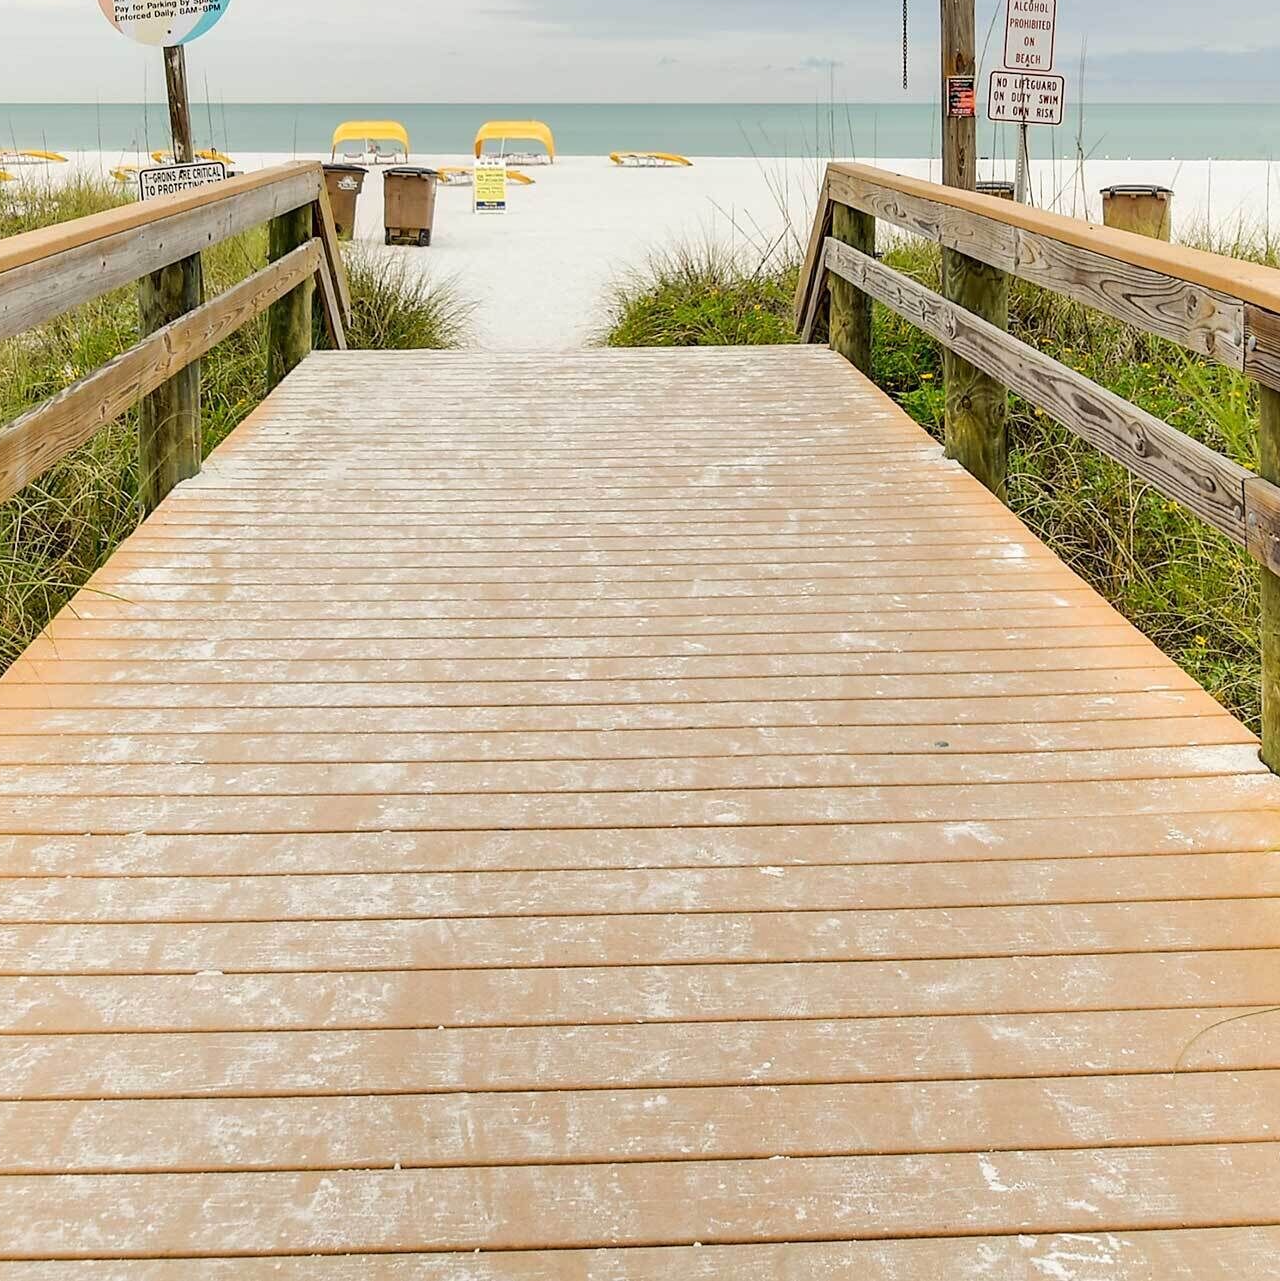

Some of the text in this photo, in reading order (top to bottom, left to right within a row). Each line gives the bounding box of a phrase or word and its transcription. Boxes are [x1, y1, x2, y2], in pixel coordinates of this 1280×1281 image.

[115, 5, 128, 13] Pay
[147, 1, 177, 9] Parking
[1014, 1, 1048, 13] ALCOHOL
[115, 13, 151, 22] Enforced
[1010, 18, 1051, 30] PROHIBITED
[1024, 37, 1034, 46] ON
[1016, 54, 1041, 64] BEACH
[997, 78, 1057, 91] NO LIFEGUARD
[994, 92, 1058, 104] ON DUTY SWIM
[996, 105, 1054, 118] AT OWN RISK
[145, 166, 221, 184] T-GROINS ARE CRITICAL
[145, 186, 156, 196] TO
